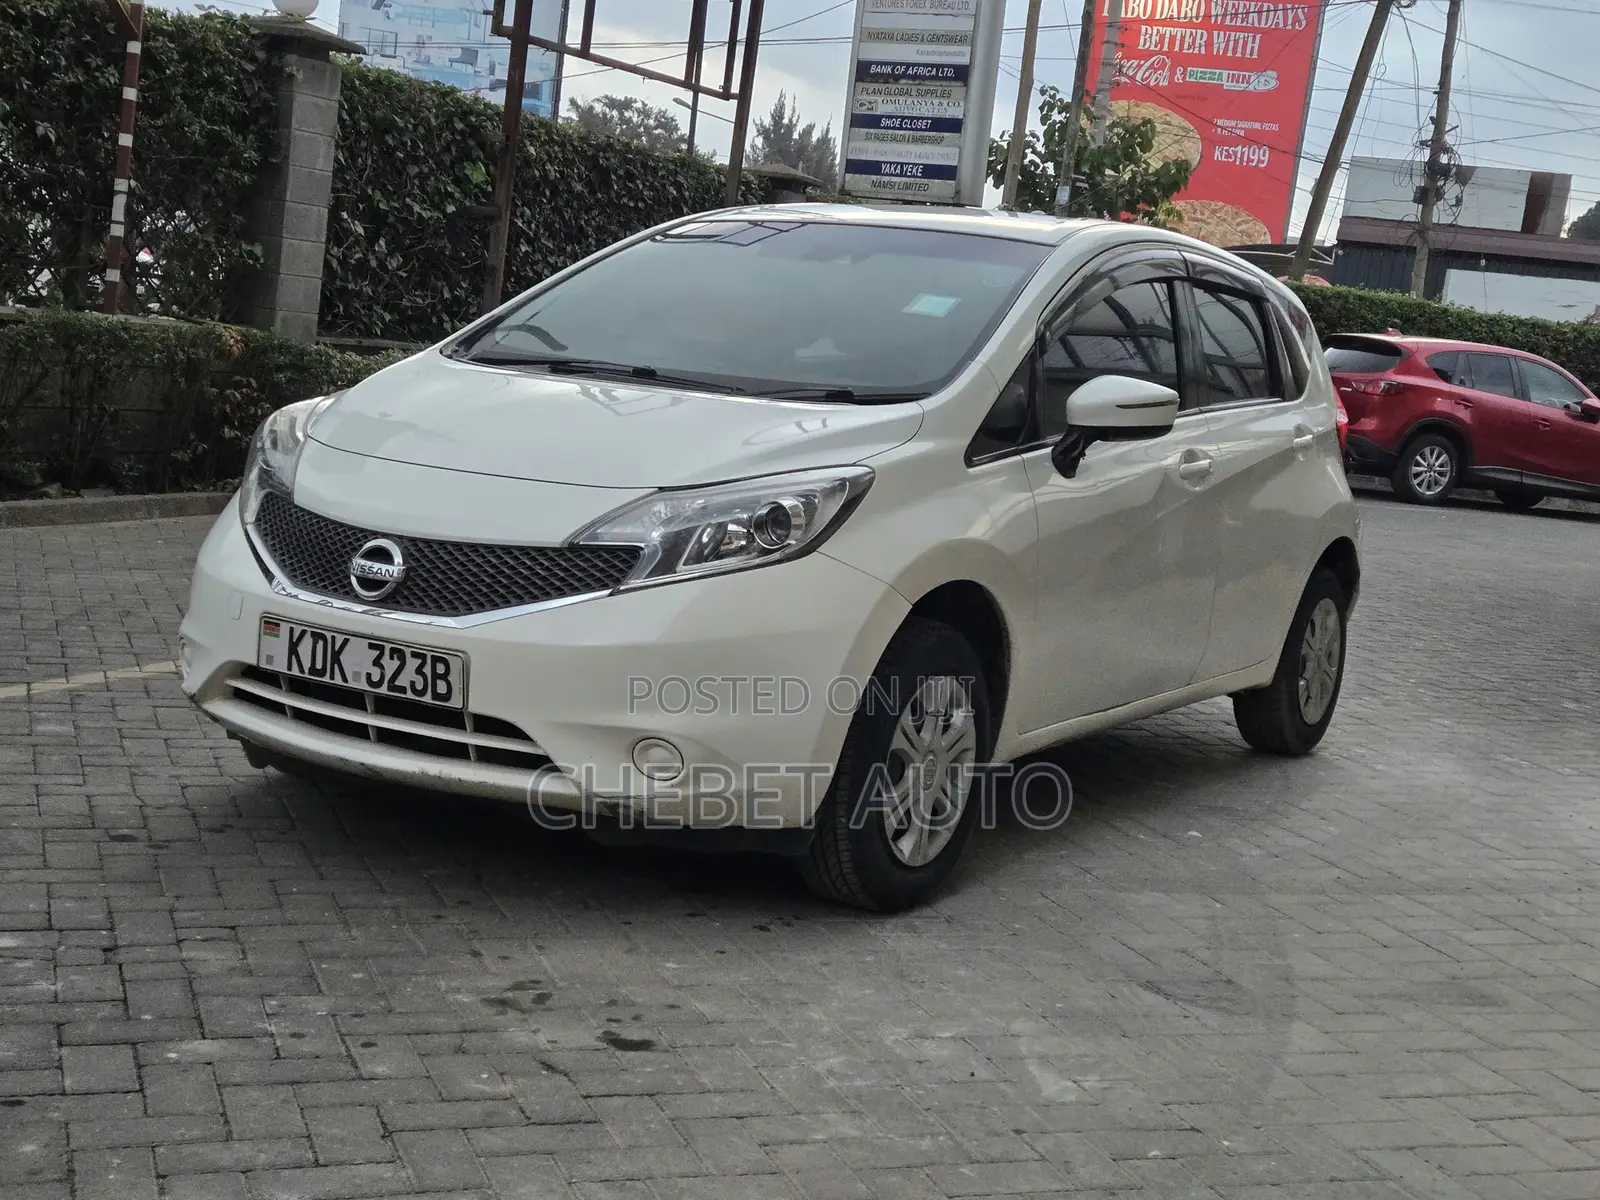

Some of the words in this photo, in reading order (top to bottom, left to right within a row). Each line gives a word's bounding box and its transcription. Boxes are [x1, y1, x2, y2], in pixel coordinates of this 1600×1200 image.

[871, 0, 904, 9] VENTURES
[905, 0, 927, 9] FOREX
[929, 0, 956, 10] BUREAU
[1102, 0, 1153, 20] BO
[1155, 0, 1206, 24] DABO
[1210, 0, 1308, 30] WEEKDAYS
[895, 32, 919, 42] LADIES
[926, 33, 969, 44] GENTSWEAR
[1137, 25, 1208, 54] BETTER
[1213, 30, 1262, 58] WITH
[870, 64, 894, 74] BANK
[894, 65, 907, 74] OF
[906, 66, 937, 76] AFRICA
[938, 68, 956, 77] LTD.
[1174, 66, 1185, 83] &
[1187, 68, 1224, 83] PIZZA
[1226, 71, 1252, 85] INN
[860, 86, 883, 96] PLAN
[883, 87, 914, 97] GLOBAL
[915, 88, 953, 98] SUPPLIES
[881, 98, 935, 107] OMULANYA
[880, 117, 902, 128] SHOE
[902, 119, 932, 129] CLOSET
[881, 162, 901, 174] YAKA
[902, 164, 924, 176] YEKE
[871, 180, 896, 190] NAMSI
[897, 180, 930, 192] LIMITED
[351, 562, 395, 578] NISSAN
[287, 626, 350, 684] KDK
[365, 641, 453, 703] 323B
